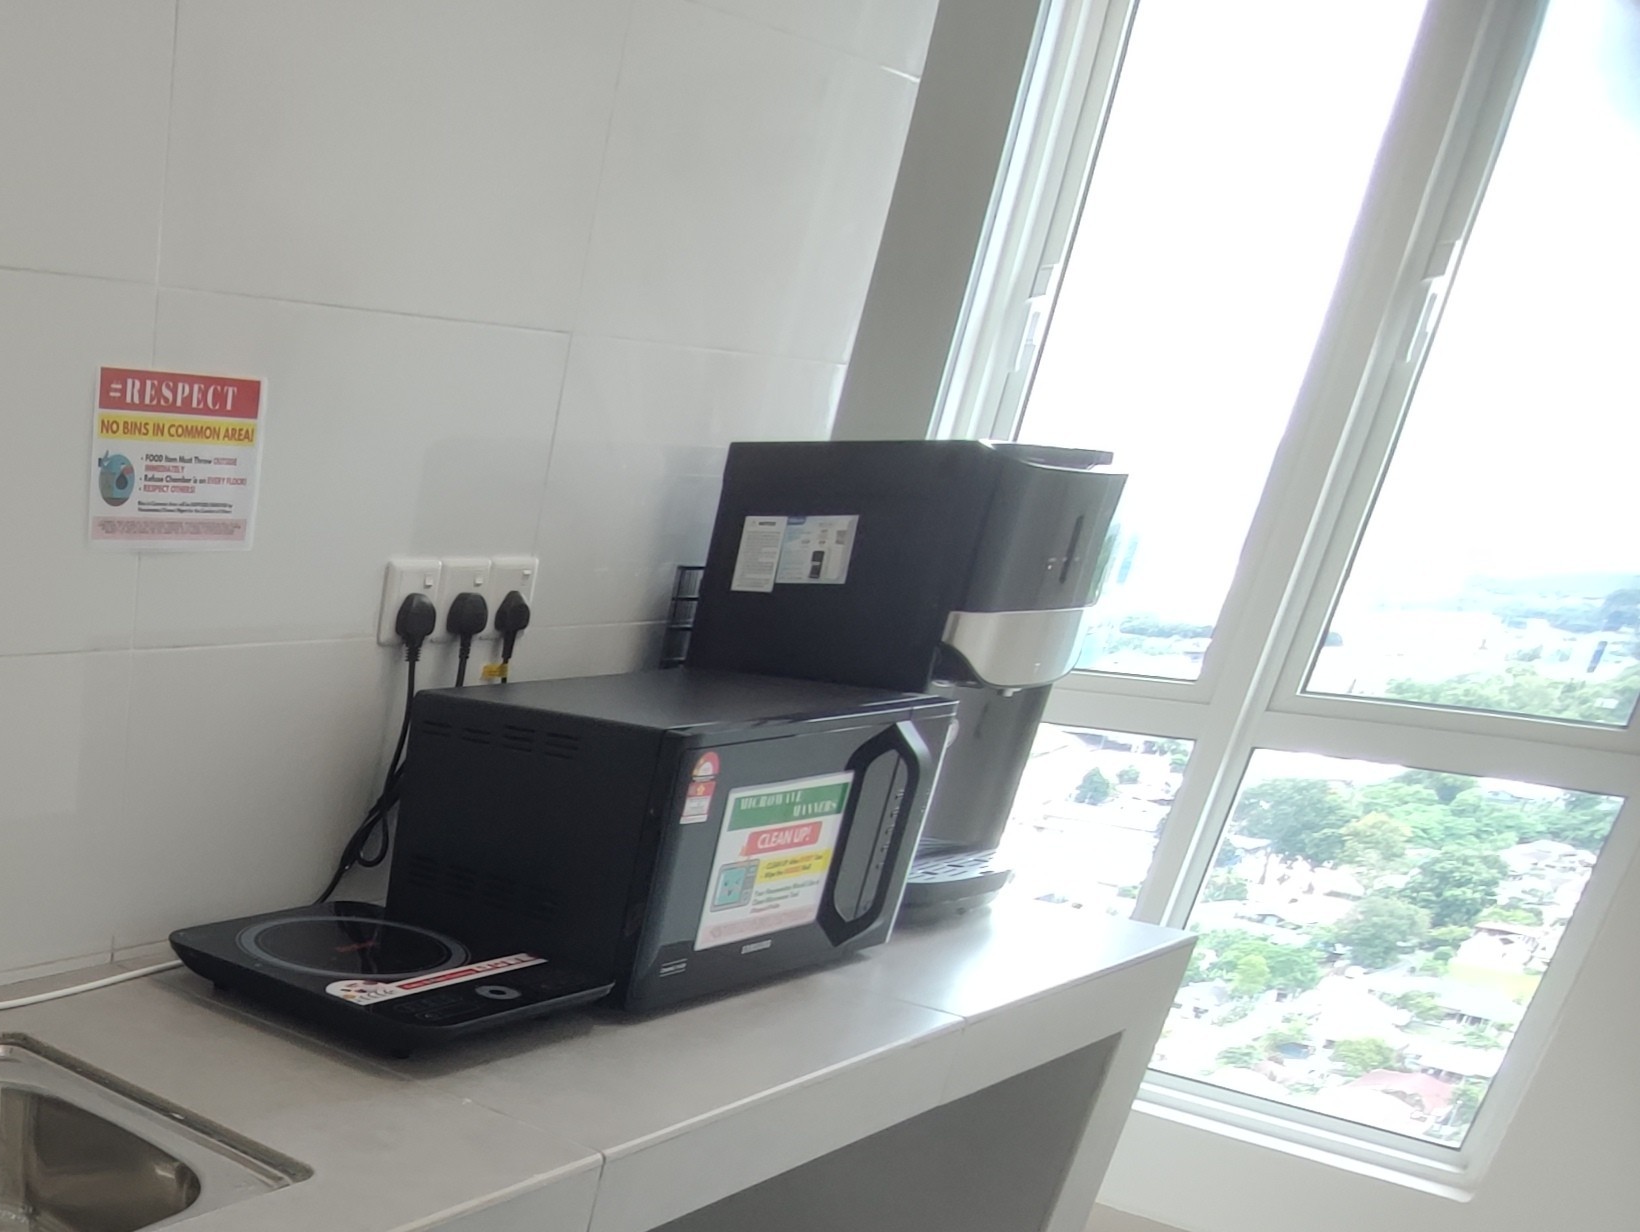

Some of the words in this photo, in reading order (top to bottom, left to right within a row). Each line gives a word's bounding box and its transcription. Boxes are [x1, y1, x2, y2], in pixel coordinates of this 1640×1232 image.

[100, 420, 120, 434] NO
[122, 422, 149, 436] BINS
[153, 423, 165, 437] IN
[167, 424, 221, 441] COMMON
[222, 428, 254, 442] AREA!
[145, 454, 164, 462] FOOD
[757, 830, 792, 849] CLEAN
